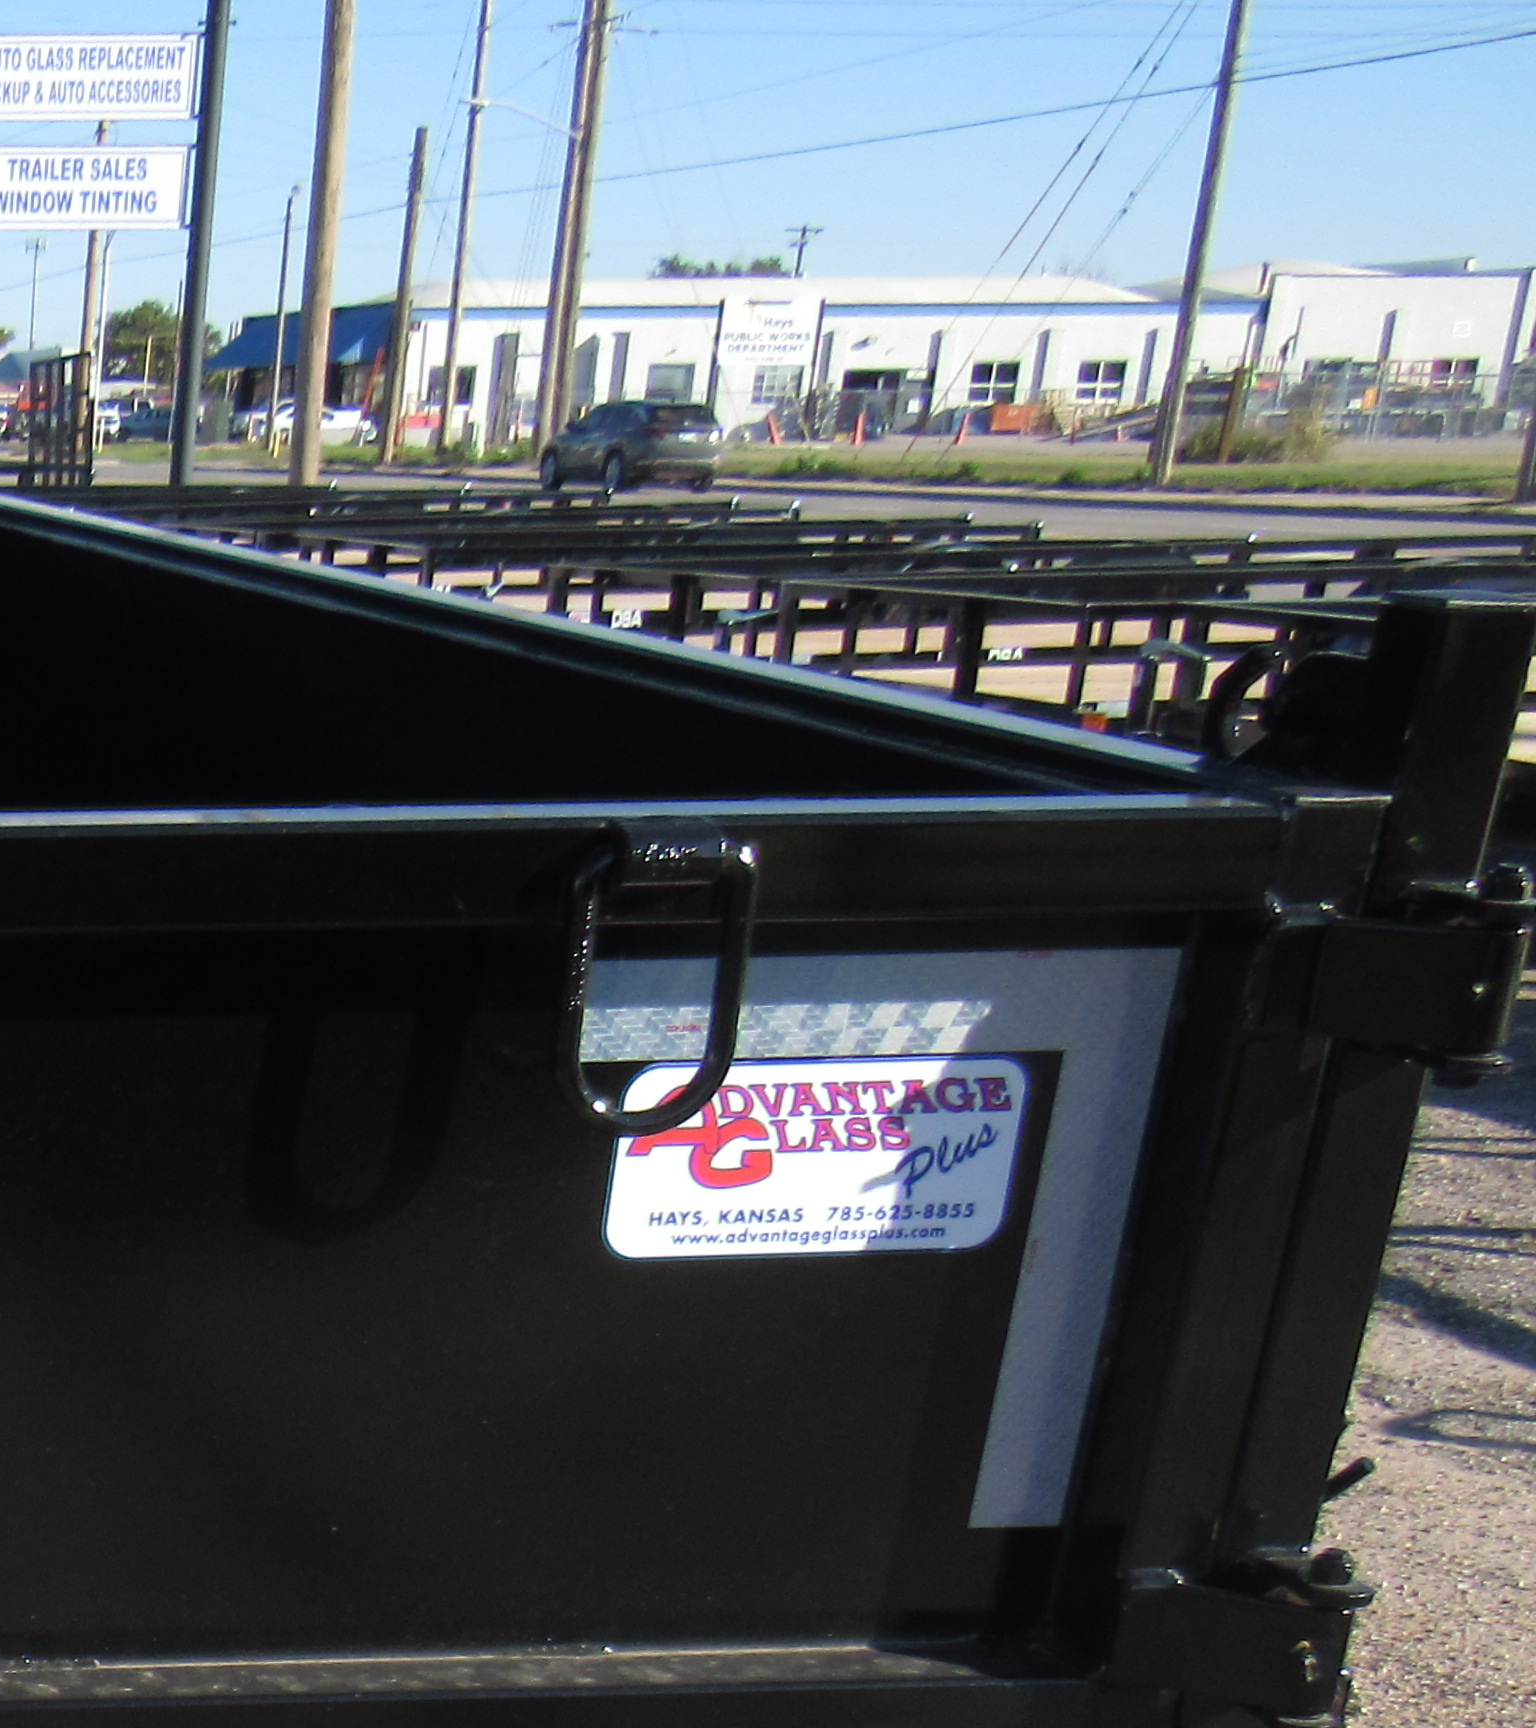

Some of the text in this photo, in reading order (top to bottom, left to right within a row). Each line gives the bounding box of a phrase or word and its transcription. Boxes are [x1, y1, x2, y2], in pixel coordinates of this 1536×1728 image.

[27, 47, 74, 72] GLASS
[78, 46, 186, 72] REPLACEMENT
[34, 81, 44, 104] &
[49, 80, 85, 103] AUTO
[88, 80, 182, 104] ACCESSORIES
[7, 157, 148, 182] TRAILER SALES
[79, 190, 158, 214] TINTING
[727, 343, 805, 353] DEPARTMENT
[860, 1122, 999, 1199] Plus
[648, 1203, 976, 1227] HAYS, KANSAS 785-625-8855
[671, 1224, 947, 1246] www.advantageglassplus.com
